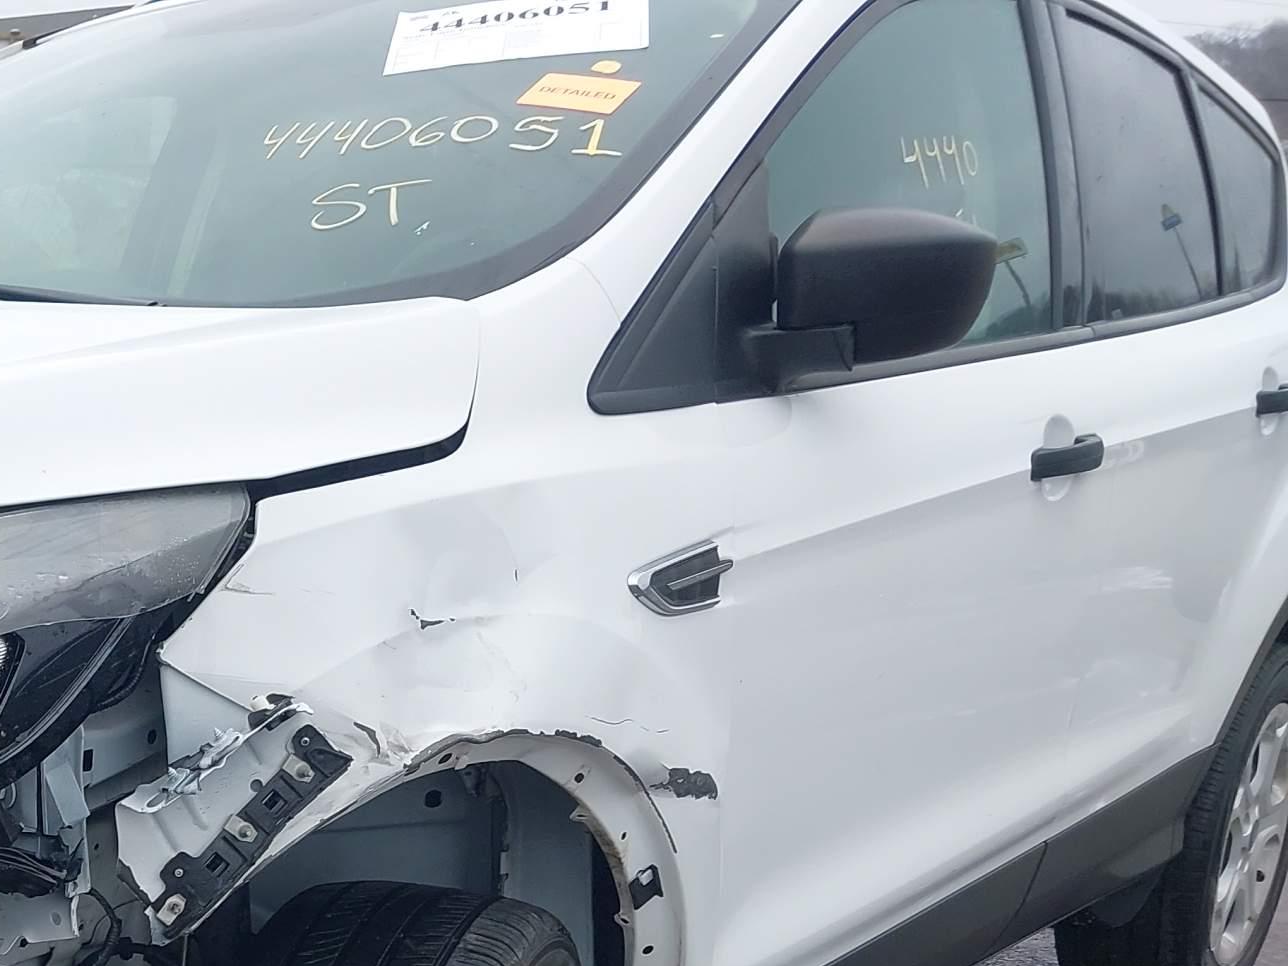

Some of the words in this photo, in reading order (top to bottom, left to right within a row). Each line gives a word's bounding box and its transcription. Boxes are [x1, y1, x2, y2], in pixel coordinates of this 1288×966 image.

[419, 0, 610, 32] 44406051
[538, 84, 617, 102] DETAILED
[900, 133, 979, 191] 4440
